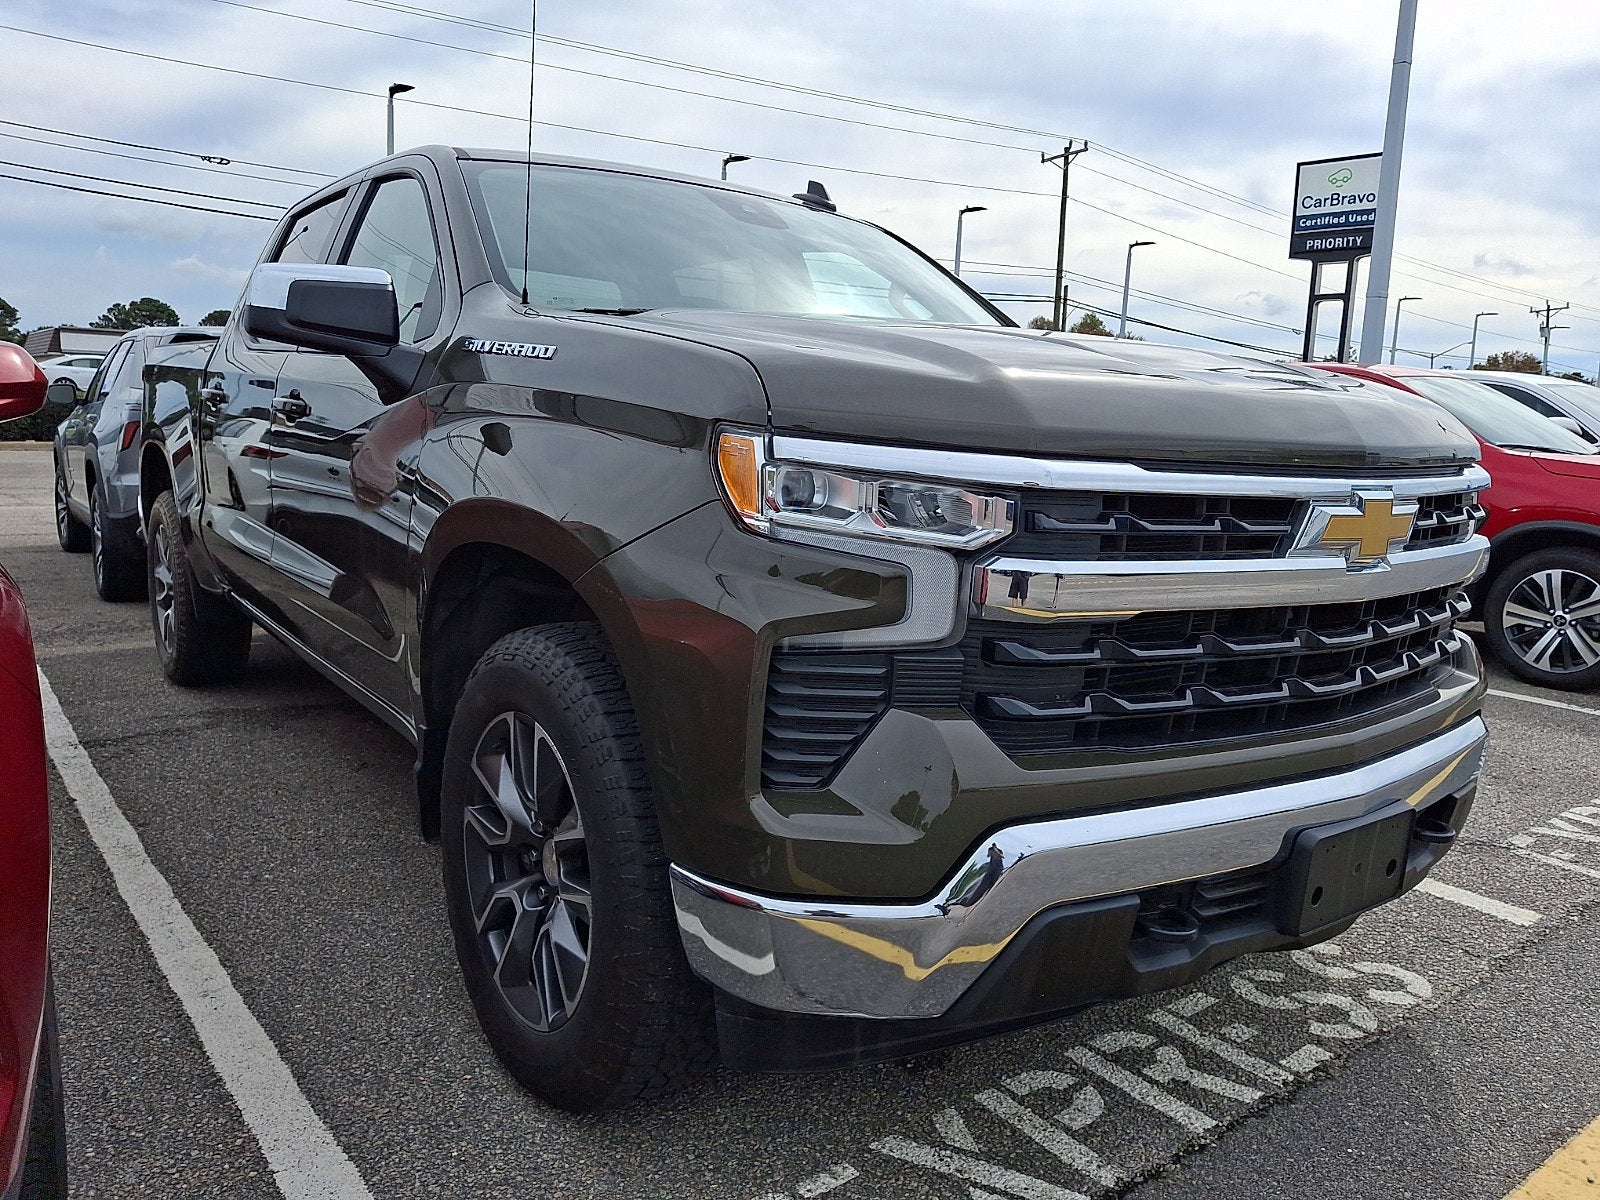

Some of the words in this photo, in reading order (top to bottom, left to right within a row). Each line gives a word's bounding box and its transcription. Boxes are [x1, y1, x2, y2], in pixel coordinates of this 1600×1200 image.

[1302, 193, 1376, 208] CarBravo
[1299, 215, 1345, 226] Certified
[1348, 213, 1375, 222] Used
[1306, 235, 1363, 250] PRIORITY
[464, 339, 557, 359] SILVERADO
